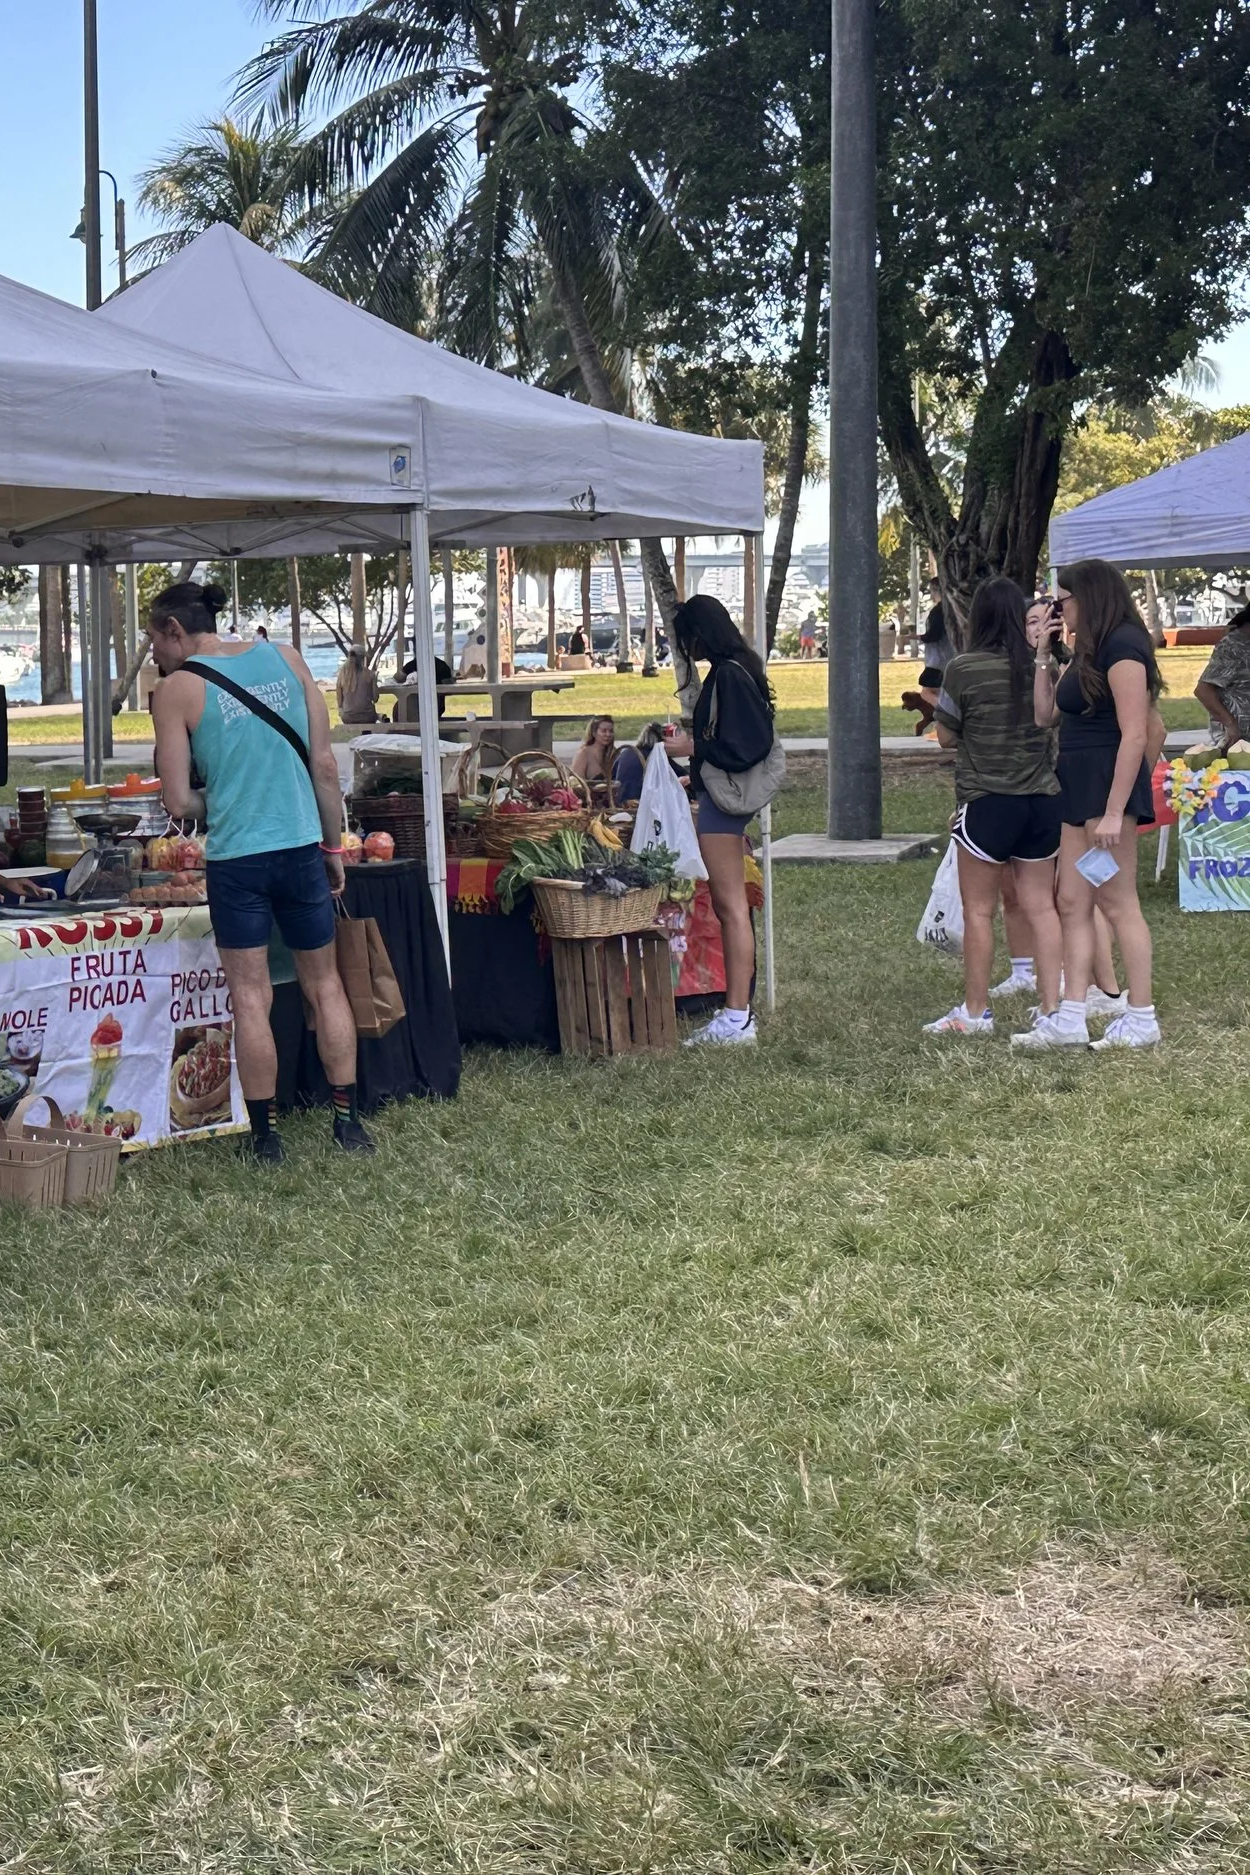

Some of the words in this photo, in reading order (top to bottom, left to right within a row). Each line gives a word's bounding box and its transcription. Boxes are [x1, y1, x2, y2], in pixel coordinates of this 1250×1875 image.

[70, 949, 147, 982] FRUTA
[68, 978, 147, 1013] PICADA
[170, 968, 211, 997] PICO
